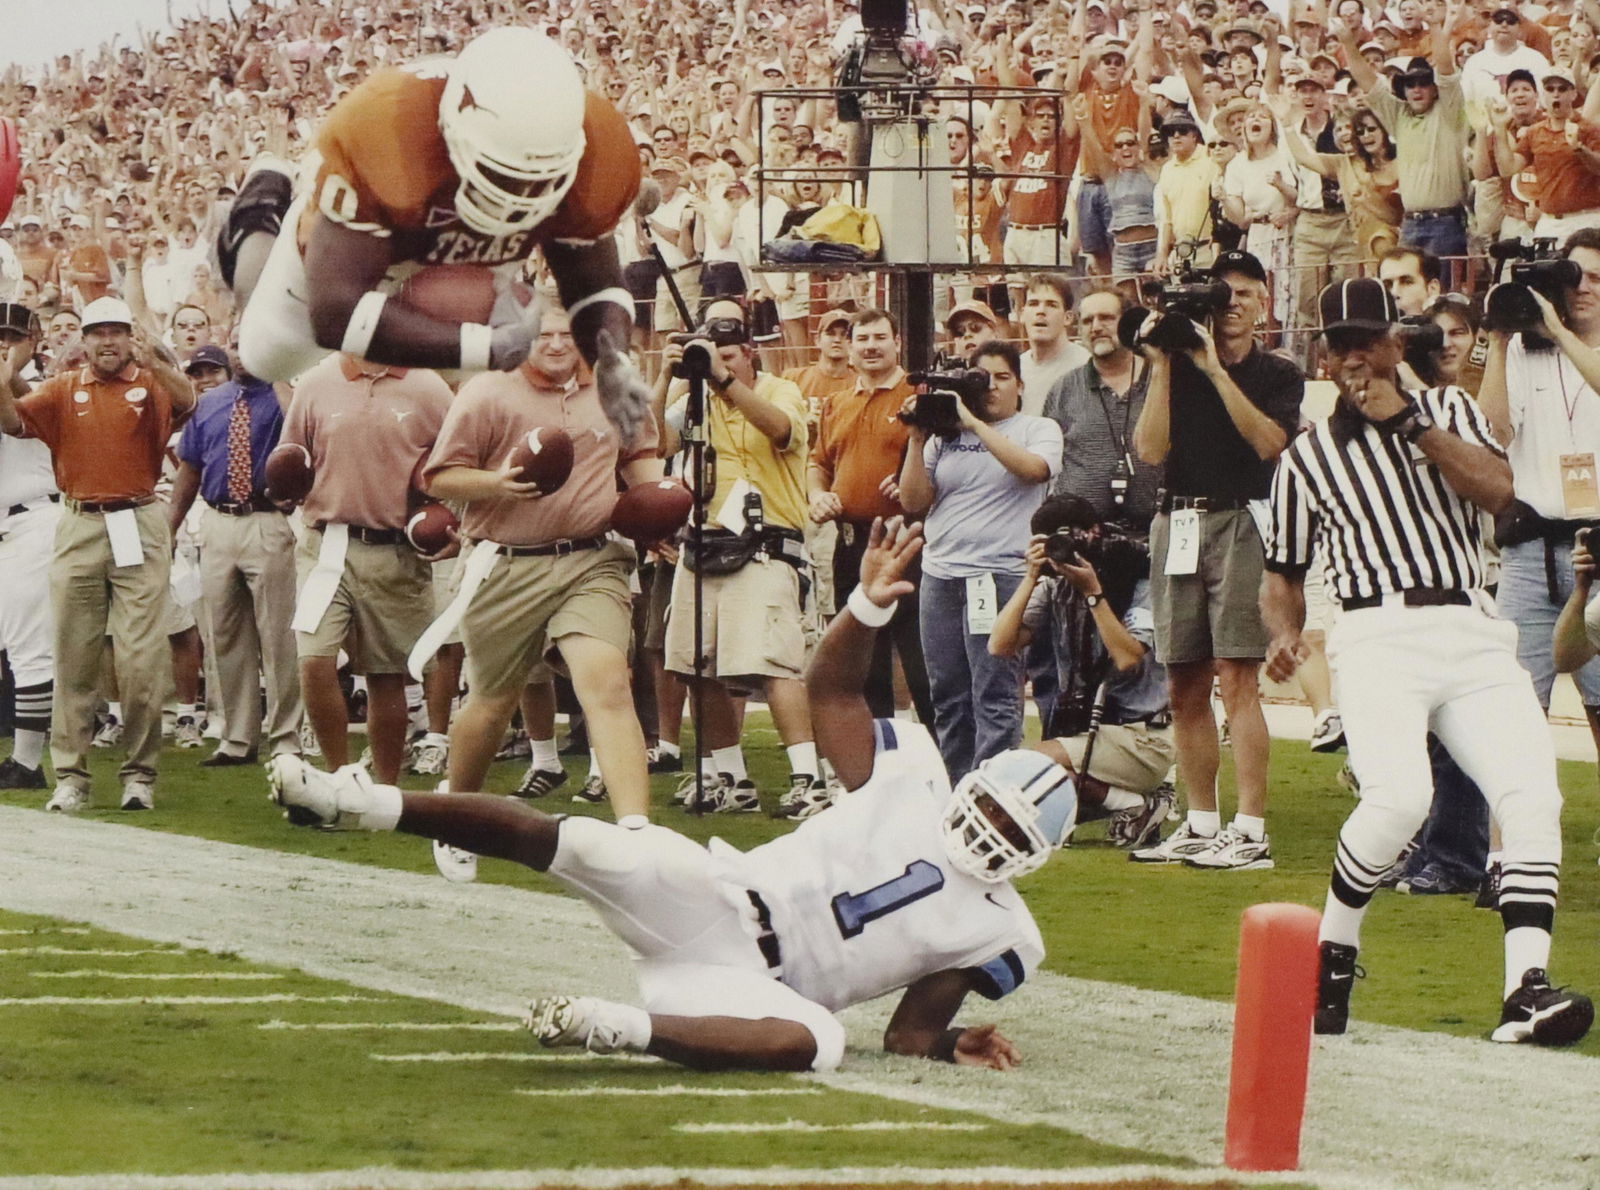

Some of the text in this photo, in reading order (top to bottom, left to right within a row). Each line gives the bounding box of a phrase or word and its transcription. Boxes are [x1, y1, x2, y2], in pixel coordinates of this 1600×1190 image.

[1180, 538, 1188, 550] 2
[977, 598, 986, 610] 2
[831, 859, 945, 941] 1
